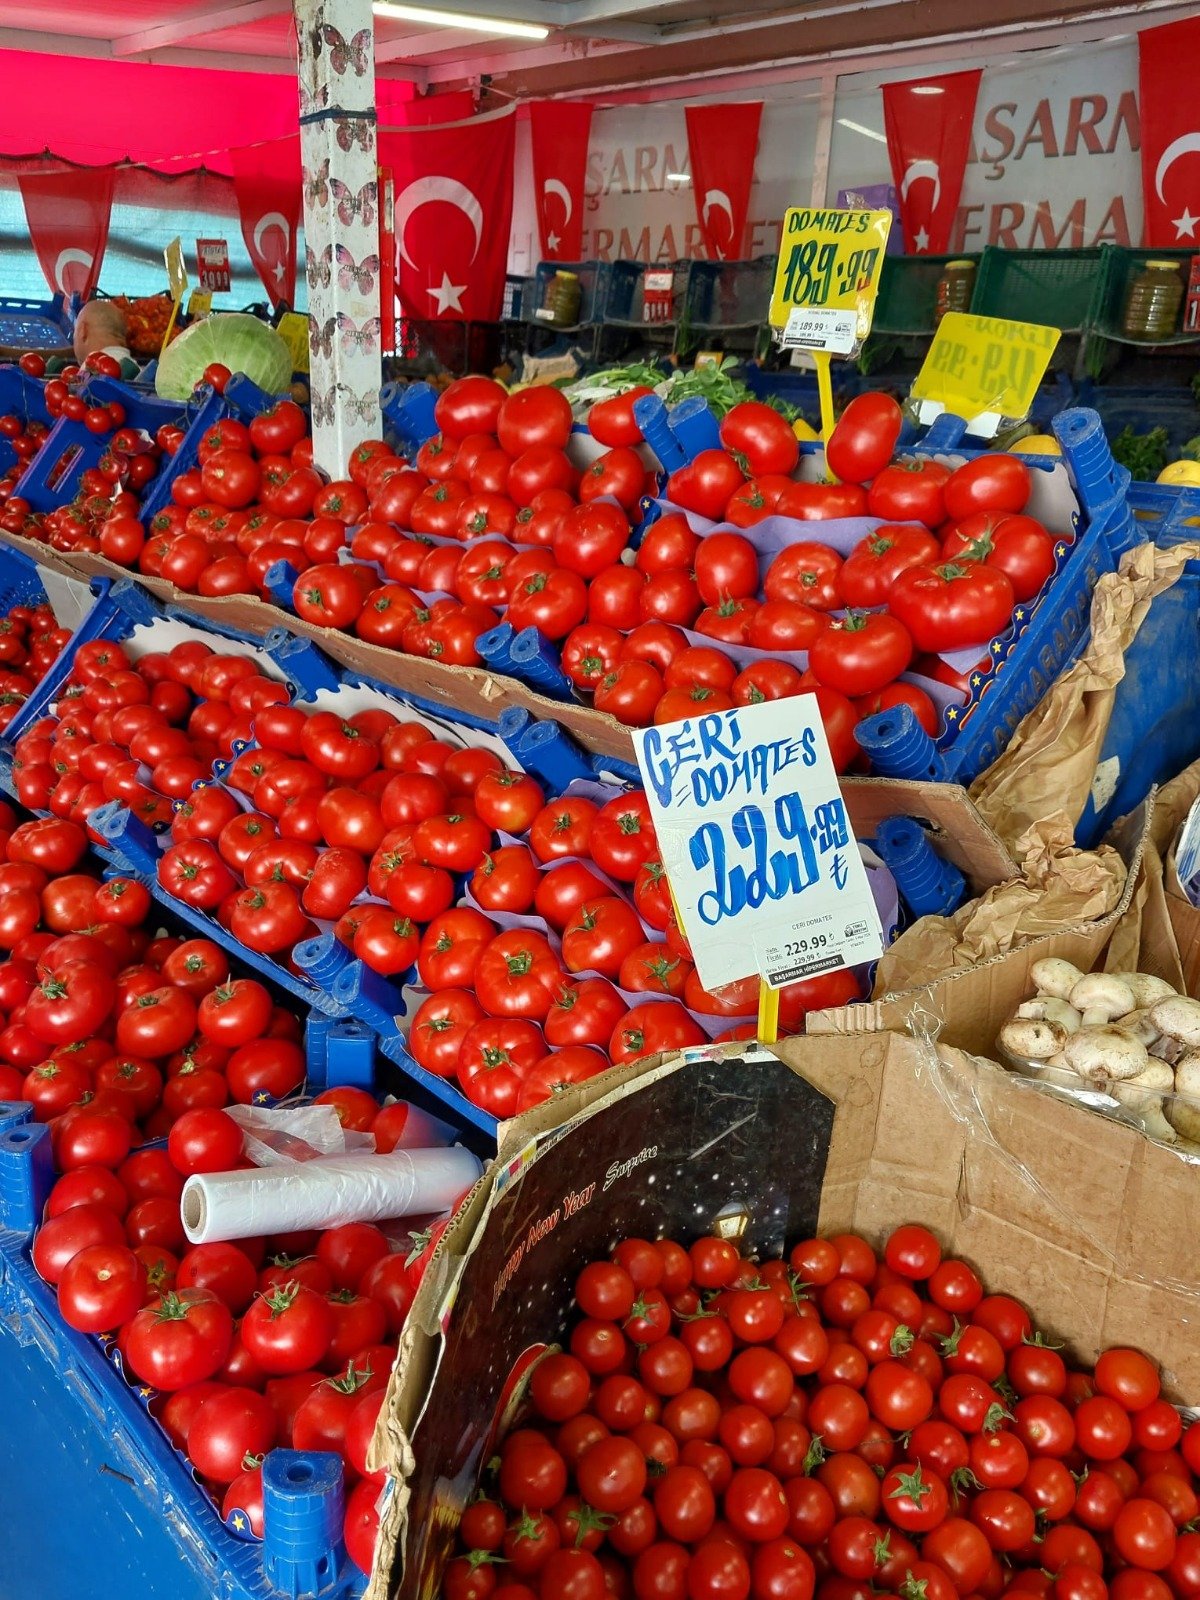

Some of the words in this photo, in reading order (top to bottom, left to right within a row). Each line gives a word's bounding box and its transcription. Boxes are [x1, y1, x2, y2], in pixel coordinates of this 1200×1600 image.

[788, 210, 871, 234] DOMATES
[690, 727, 816, 807] DOMATES
[784, 934, 828, 957] 229.99
[526, 1208, 561, 1253] New
[563, 1181, 597, 1221] Year
[602, 1145, 658, 1192] Surprise
